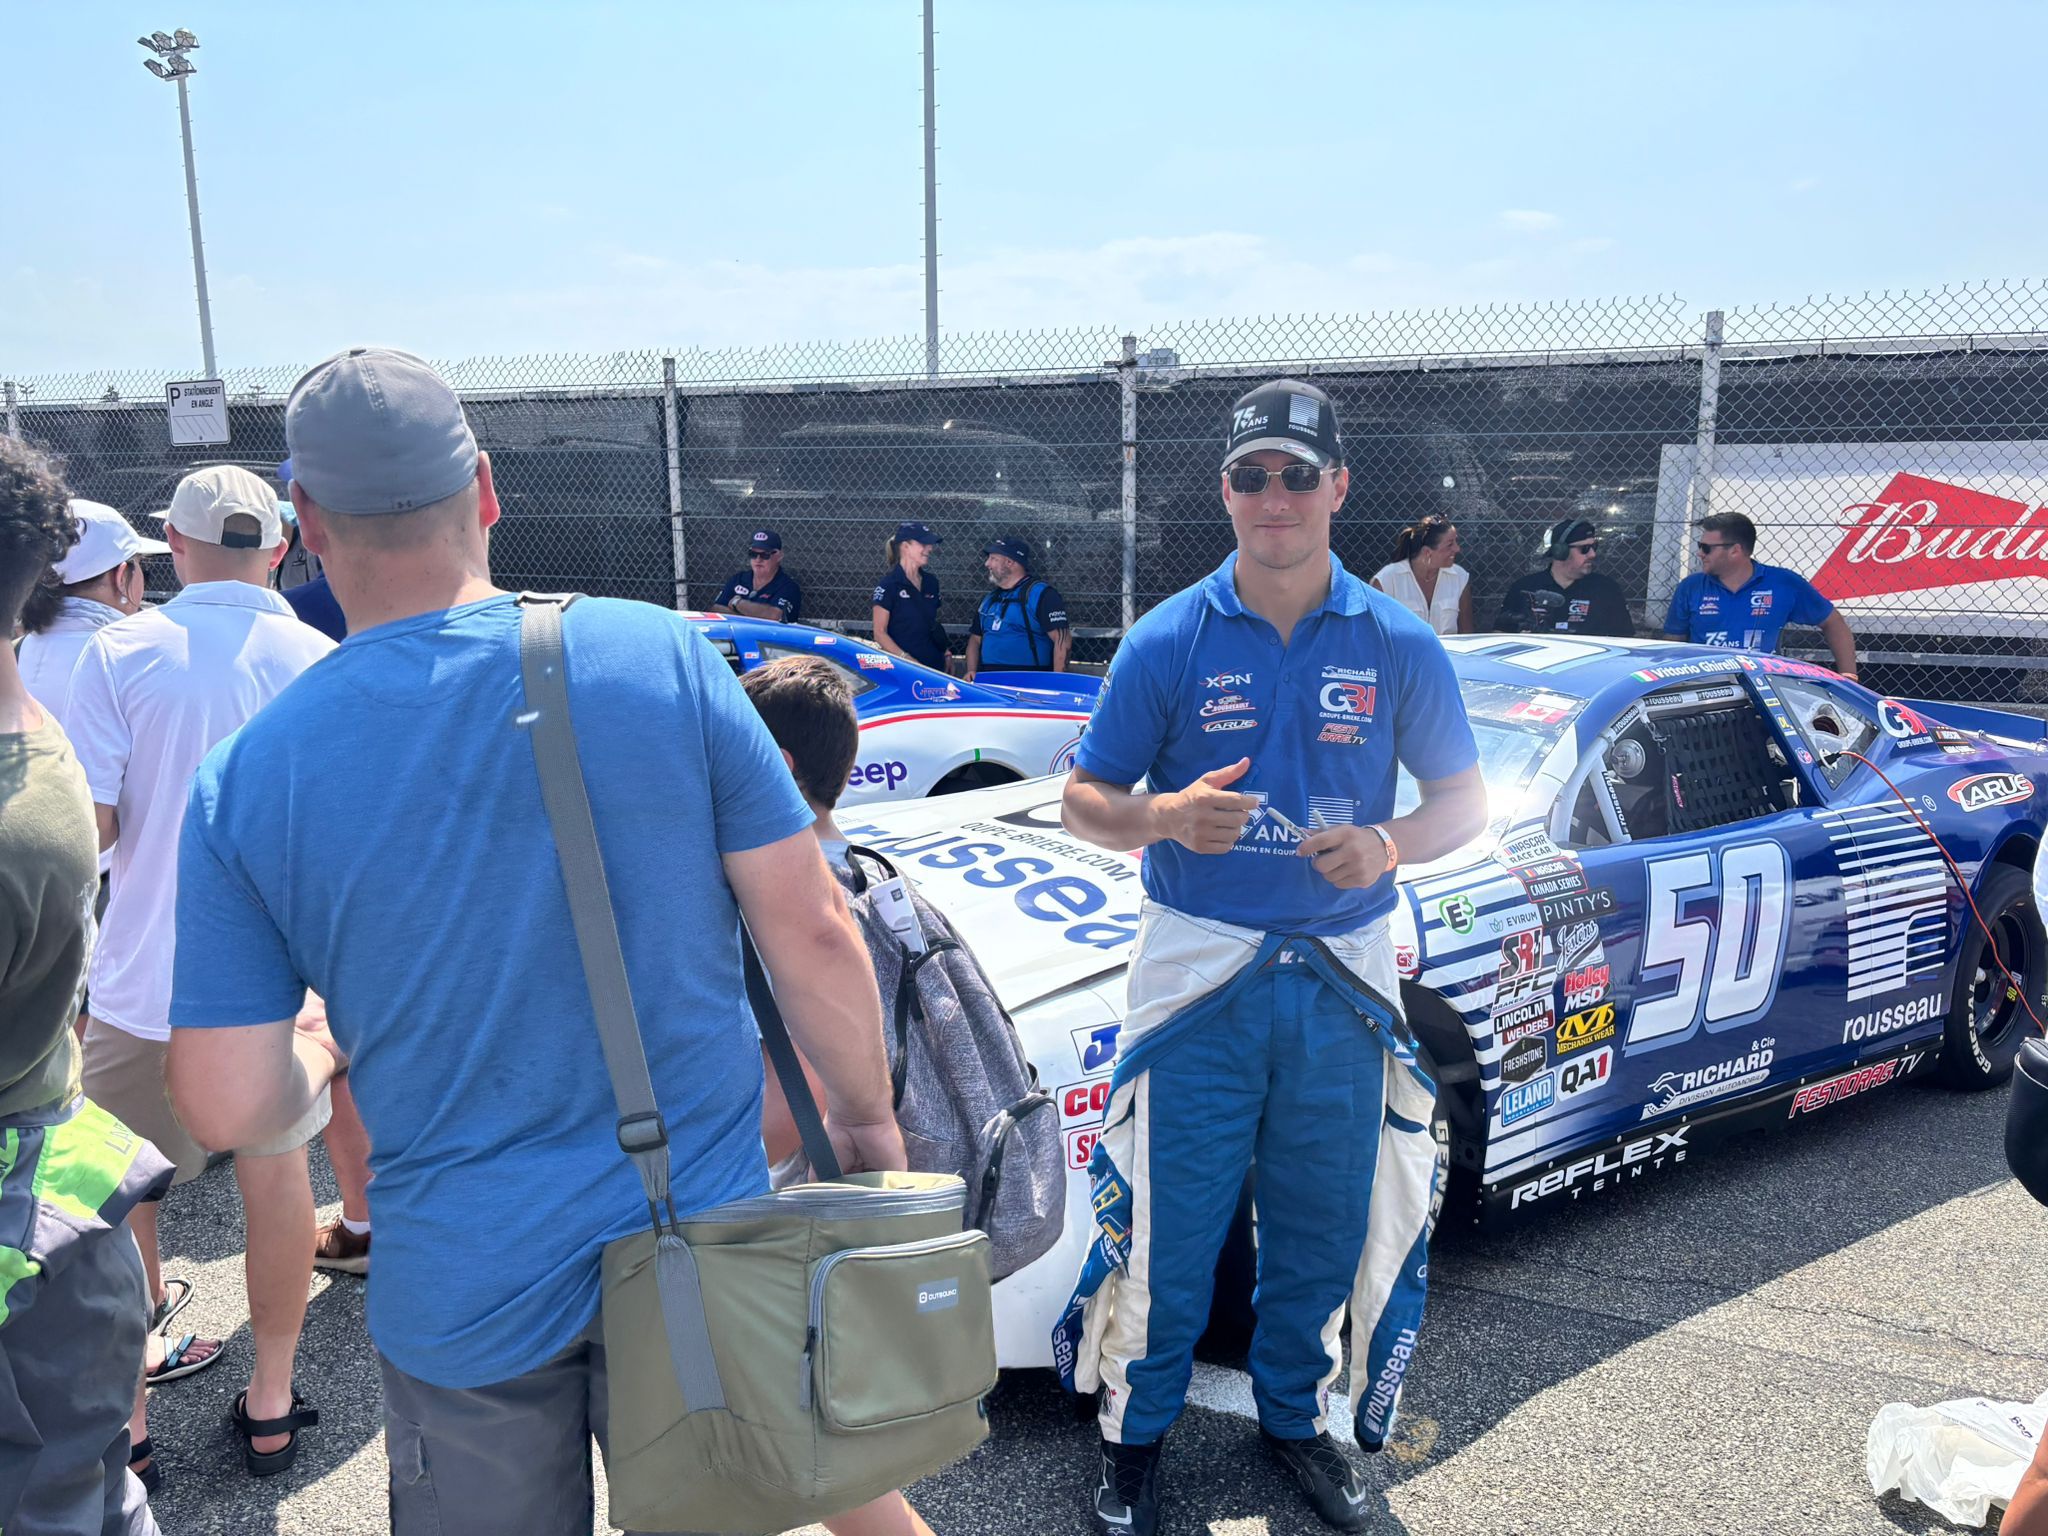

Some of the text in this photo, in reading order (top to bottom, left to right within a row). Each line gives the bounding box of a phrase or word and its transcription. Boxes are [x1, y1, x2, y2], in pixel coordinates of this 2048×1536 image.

[170, 387, 181, 407] P
[184, 385, 221, 396] STATIONNEMENT
[191, 398, 214, 408] EN ANGLE
[1247, 415, 1269, 428] ANS
[1705, 631, 1728, 646] 75
[1721, 640, 1740, 648] ANS
[1205, 674, 1252, 688] XPN
[1652, 661, 1699, 679] Vittorio
[1699, 656, 1741, 673] Ghirelli
[1648, 694, 1682, 705] rousseau
[1702, 687, 1733, 699] rousseau
[1615, 707, 1639, 731] rousseau
[848, 761, 908, 790] eep
[1955, 773, 2031, 813] LARUE
[1509, 846, 1552, 864] RACE CAR
[1511, 834, 1548, 853] NASCAR
[1533, 861, 1567, 875] NASCAR
[1530, 875, 1581, 897] CANADA SERIES
[1506, 911, 1538, 927] EVIRUM
[1543, 891, 1611, 922] PINTY'S
[1625, 840, 1792, 1053] 50
[1494, 965, 1557, 1005] PFC
[1564, 964, 1610, 996] Holley
[1564, 986, 1605, 1013] MSD
[1495, 1001, 1544, 1033] LINCOLN
[1507, 1017, 1549, 1042] WELDERS
[1842, 993, 1943, 1044] rousseau
[1557, 1025, 1615, 1055] MECHANIX WEAR
[1752, 1037, 1776, 1051] & Cie
[1503, 1046, 1544, 1073] FRESHSTONE
[1561, 1051, 1609, 1094] QA1
[1682, 1049, 1774, 1091] RICHARD
[1505, 1078, 1552, 1116] LELAND
[1679, 1073, 1767, 1105] DIVISION AUTOMOBILE
[1788, 1051, 1925, 1119] FESTIDRAG.TV
[1064, 1082, 1111, 1118] CO
[1571, 1150, 1687, 1200] TEINTE
[1054, 1324, 1074, 1378] seau
[1366, 1328, 1416, 1423] rousseau
